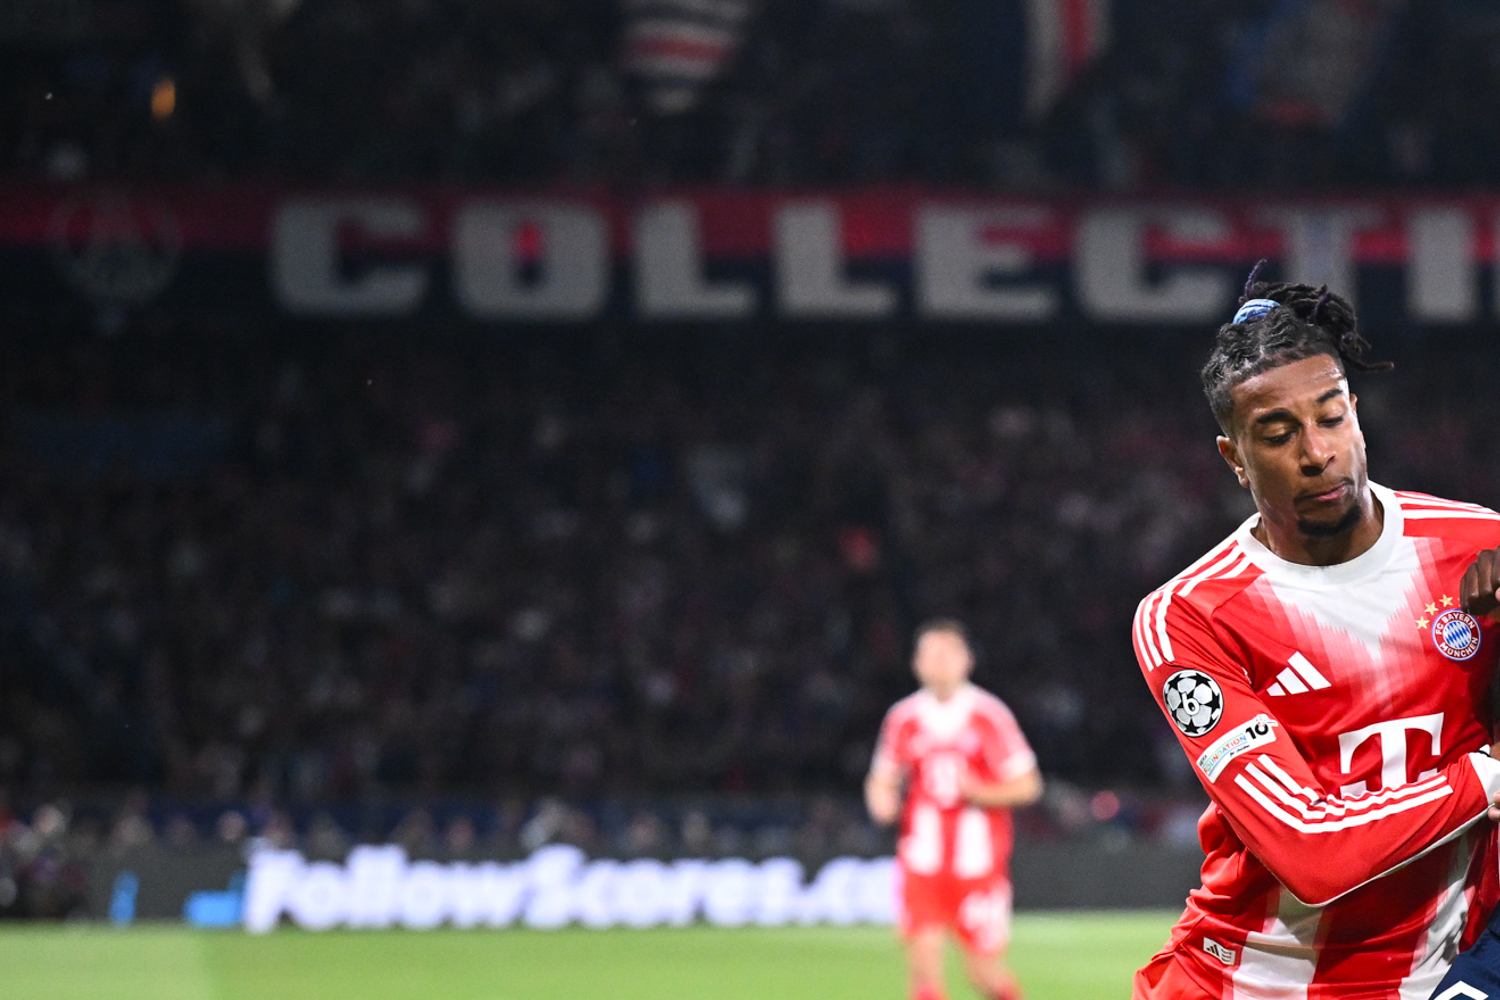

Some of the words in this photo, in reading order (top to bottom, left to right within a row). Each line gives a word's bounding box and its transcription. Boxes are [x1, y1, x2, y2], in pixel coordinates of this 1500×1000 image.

[1435, 623, 1444, 635] FC
[1441, 612, 1476, 629] BAYERN
[1245, 723, 1269, 740] 10
[1204, 735, 1247, 775] FOUNDATION
[1339, 713, 1444, 799] T
[243, 844, 902, 932] FollowScores.co
